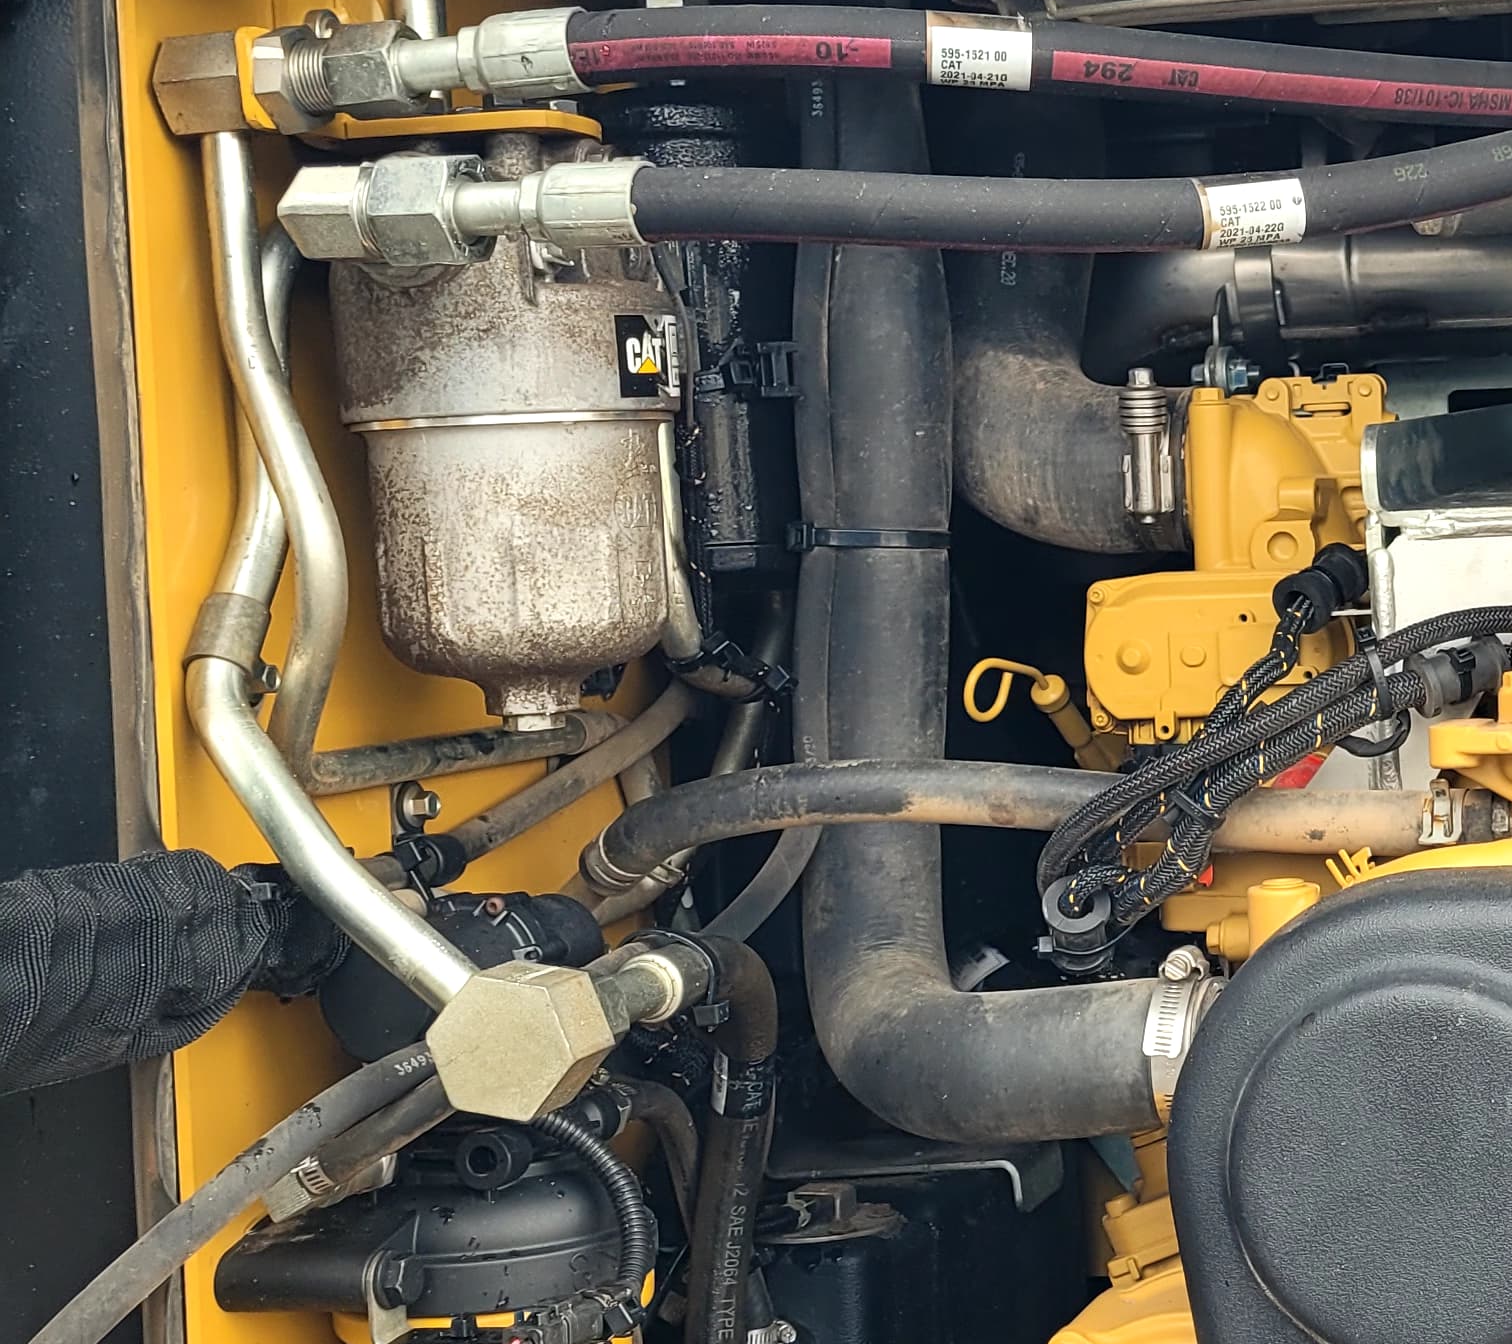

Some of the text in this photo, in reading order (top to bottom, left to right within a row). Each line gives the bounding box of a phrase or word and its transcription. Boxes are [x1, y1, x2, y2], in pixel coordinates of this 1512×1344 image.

[940, 59, 962, 70] CAT
[941, 48, 1007, 62] 595-1521 00
[1083, 60, 1134, 83] 294
[1166, 68, 1199, 87] CAT
[1393, 87, 1463, 109] IC-101/38
[1468, 93, 1512, 111] MSHA
[1393, 162, 1429, 182] 226
[1220, 199, 1282, 216] 595-1522 00
[1220, 216, 1241, 228] CAT
[625, 329, 663, 374] CAT
[727, 1206, 747, 1237] SAE
[722, 1242, 741, 1286] J2064
[717, 1298, 737, 1340] TYPE
